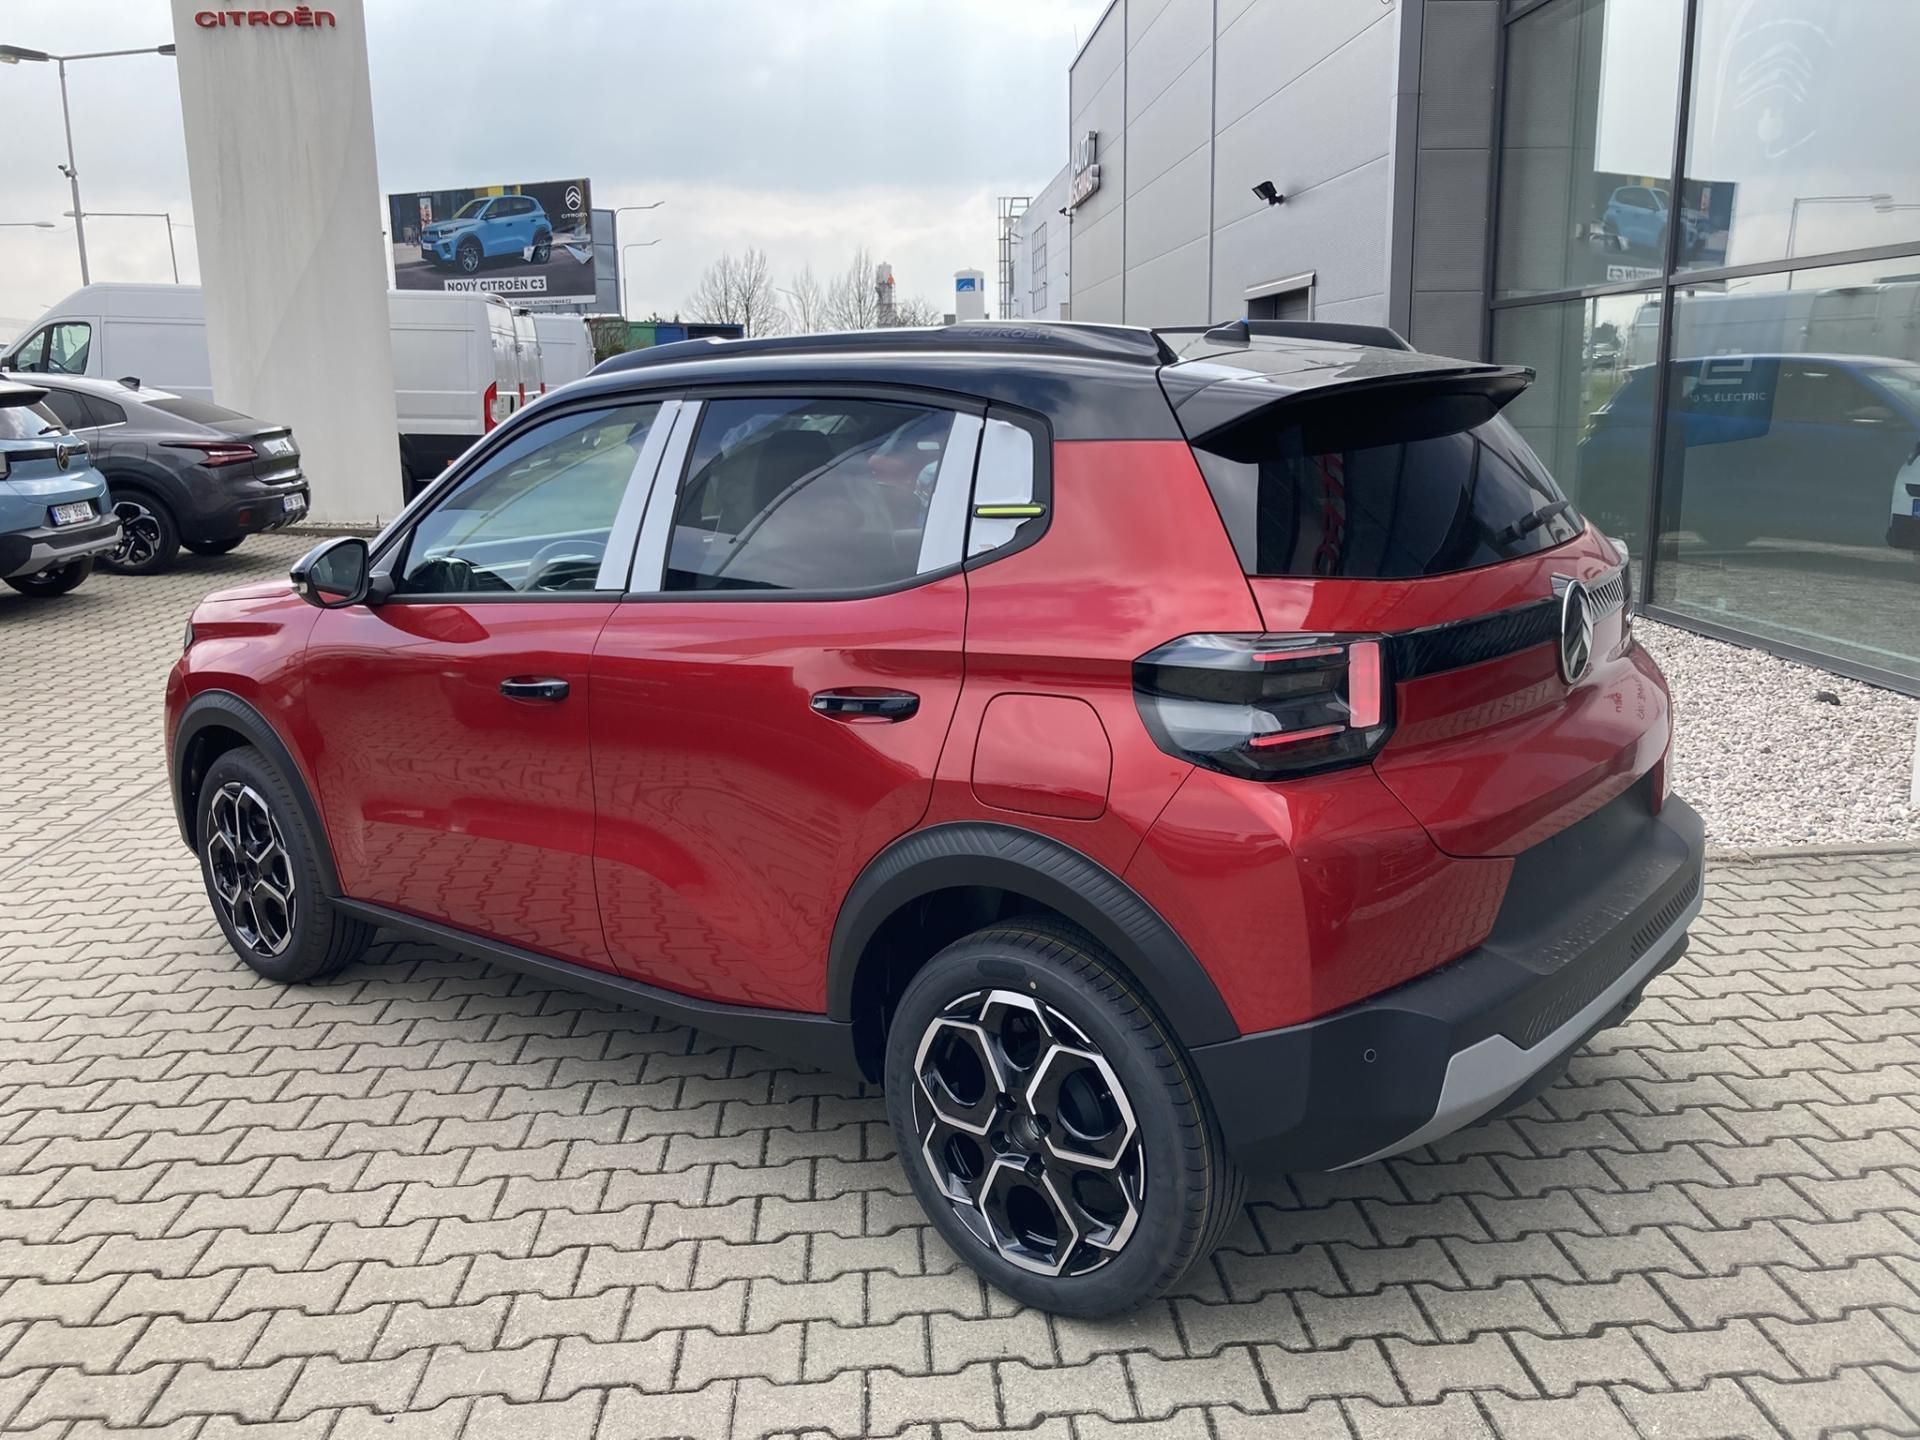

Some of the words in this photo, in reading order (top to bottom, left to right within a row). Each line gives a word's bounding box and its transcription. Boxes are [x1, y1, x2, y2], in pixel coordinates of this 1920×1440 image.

[194, 6, 336, 28] CITROËN
[447, 278, 477, 292] NOVÝ
[480, 276, 528, 291] CITROËN
[530, 279, 545, 289] C3
[1714, 392, 1768, 402] ELECTRIC
